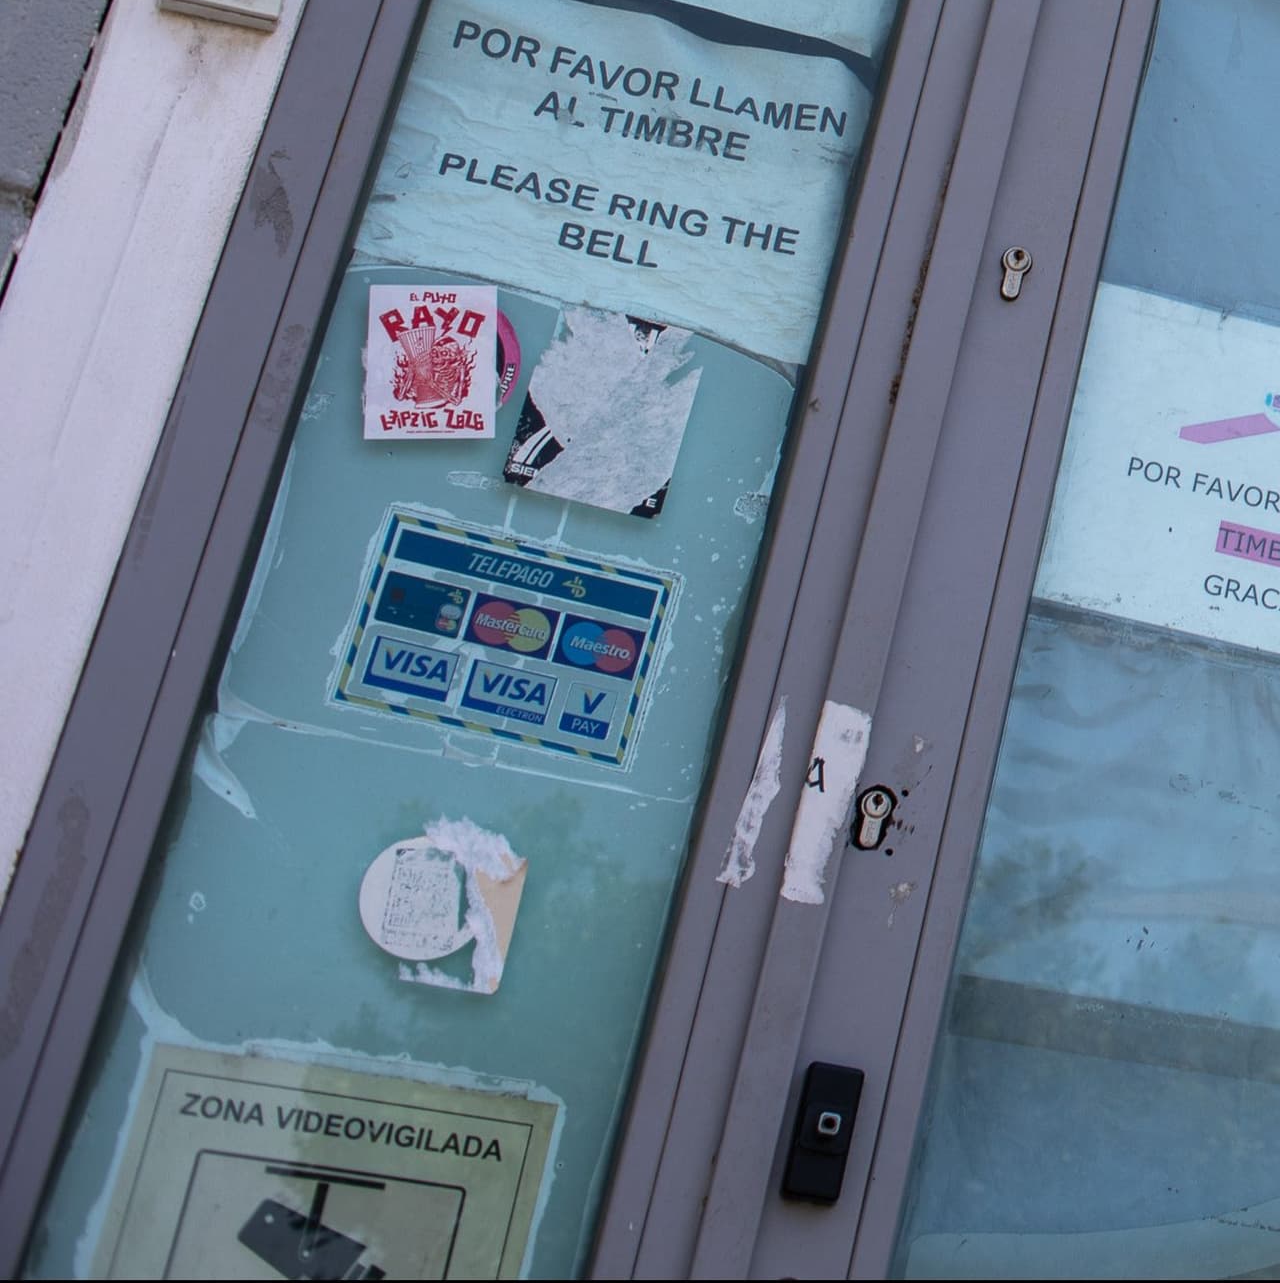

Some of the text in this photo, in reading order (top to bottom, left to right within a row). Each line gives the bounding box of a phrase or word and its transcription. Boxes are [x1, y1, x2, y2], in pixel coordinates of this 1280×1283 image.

[453, 19, 848, 137] POR FAVOR LLAMEN
[534, 91, 751, 162] AL TIMBRE
[439, 152, 800, 256] PLEASE RING THE
[558, 222, 659, 269] BELL
[379, 305, 487, 343] RAYO
[444, 408, 484, 431] 2026
[1127, 457, 1182, 489] POR
[1192, 473, 1280, 513] FAVOR
[467, 553, 555, 588] TELEPAGO
[384, 646, 449, 683] VISA
[482, 670, 549, 706] VISA
[496, 705, 599, 735] ELECTRON PAY
[180, 1092, 502, 1162] ZONA VIDEOVIGILADA
